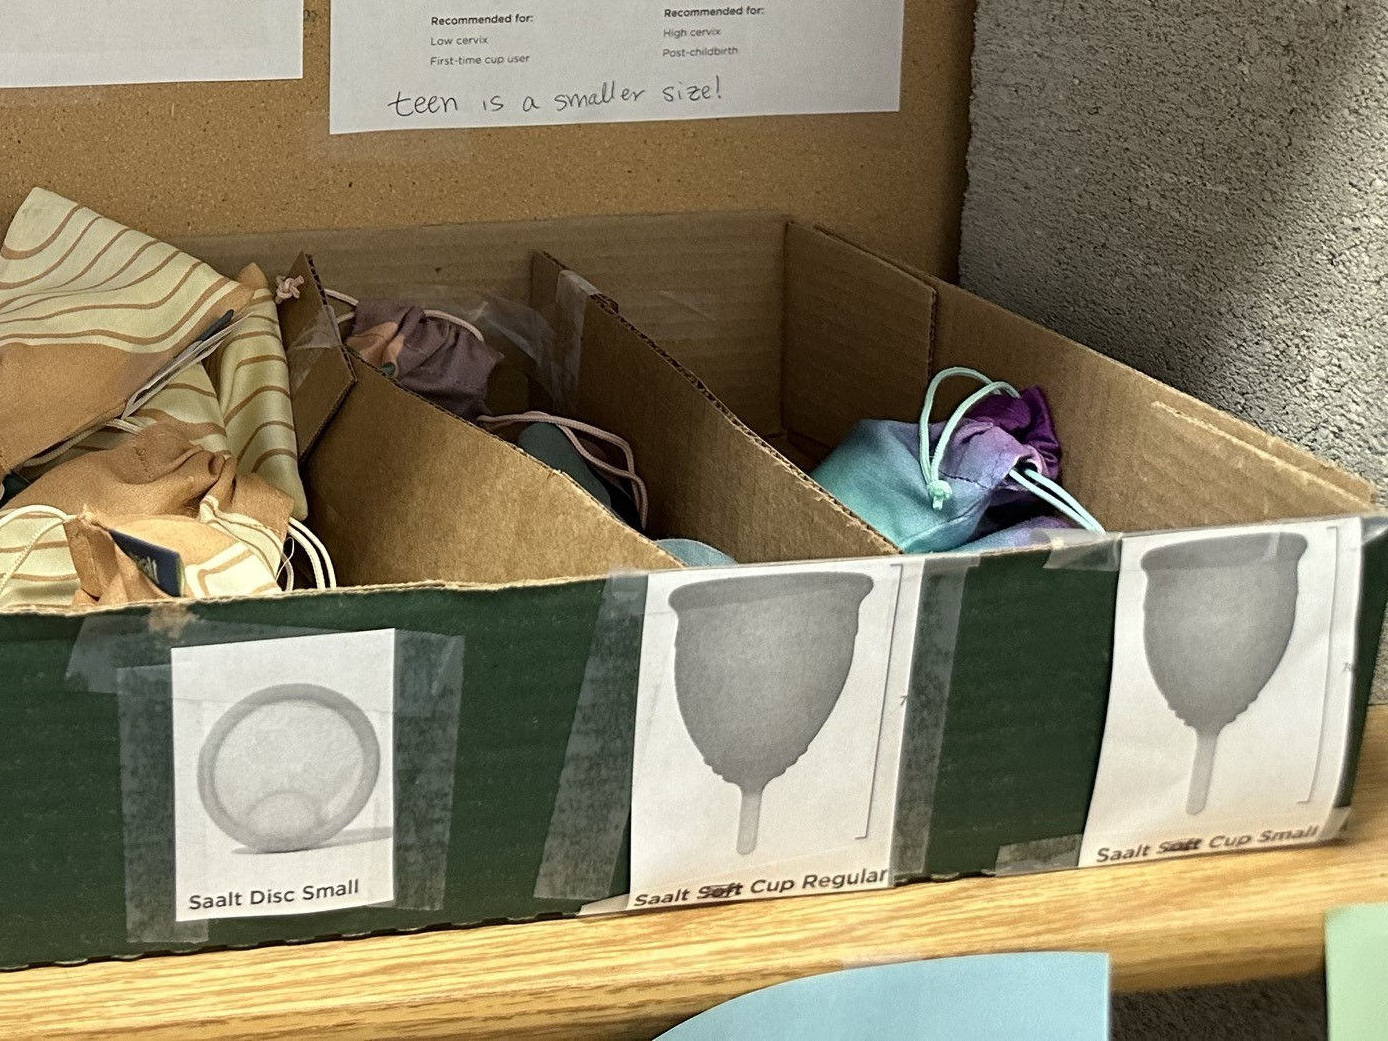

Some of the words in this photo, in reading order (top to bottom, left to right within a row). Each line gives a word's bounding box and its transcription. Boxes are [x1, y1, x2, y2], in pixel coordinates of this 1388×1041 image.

[664, 6, 743, 17] Recommended
[747, 6, 764, 15] for:
[431, 14, 512, 25] Recommended
[516, 14, 533, 22] for:
[664, 28, 687, 39] High
[690, 29, 721, 37] cervix
[431, 37, 453, 46] Low
[456, 36, 488, 45] cervix
[663, 47, 738, 57] Post-childbirth
[430, 57, 481, 65] First-time
[387, 91, 458, 117] teen
[483, 95, 504, 111] is
[522, 96, 540, 112] a
[554, 81, 645, 111] smaller
[662, 75, 721, 102] size!
[1096, 845, 1151, 863] Saalt
[1209, 834, 1252, 848] Cup
[1260, 825, 1320, 844] Small
[634, 889, 690, 906] Saalt
[750, 880, 795, 893] Cup
[802, 870, 890, 889] Regular
[190, 892, 242, 910] Saalt
[251, 889, 294, 904] Disc
[303, 879, 358, 900] Small
